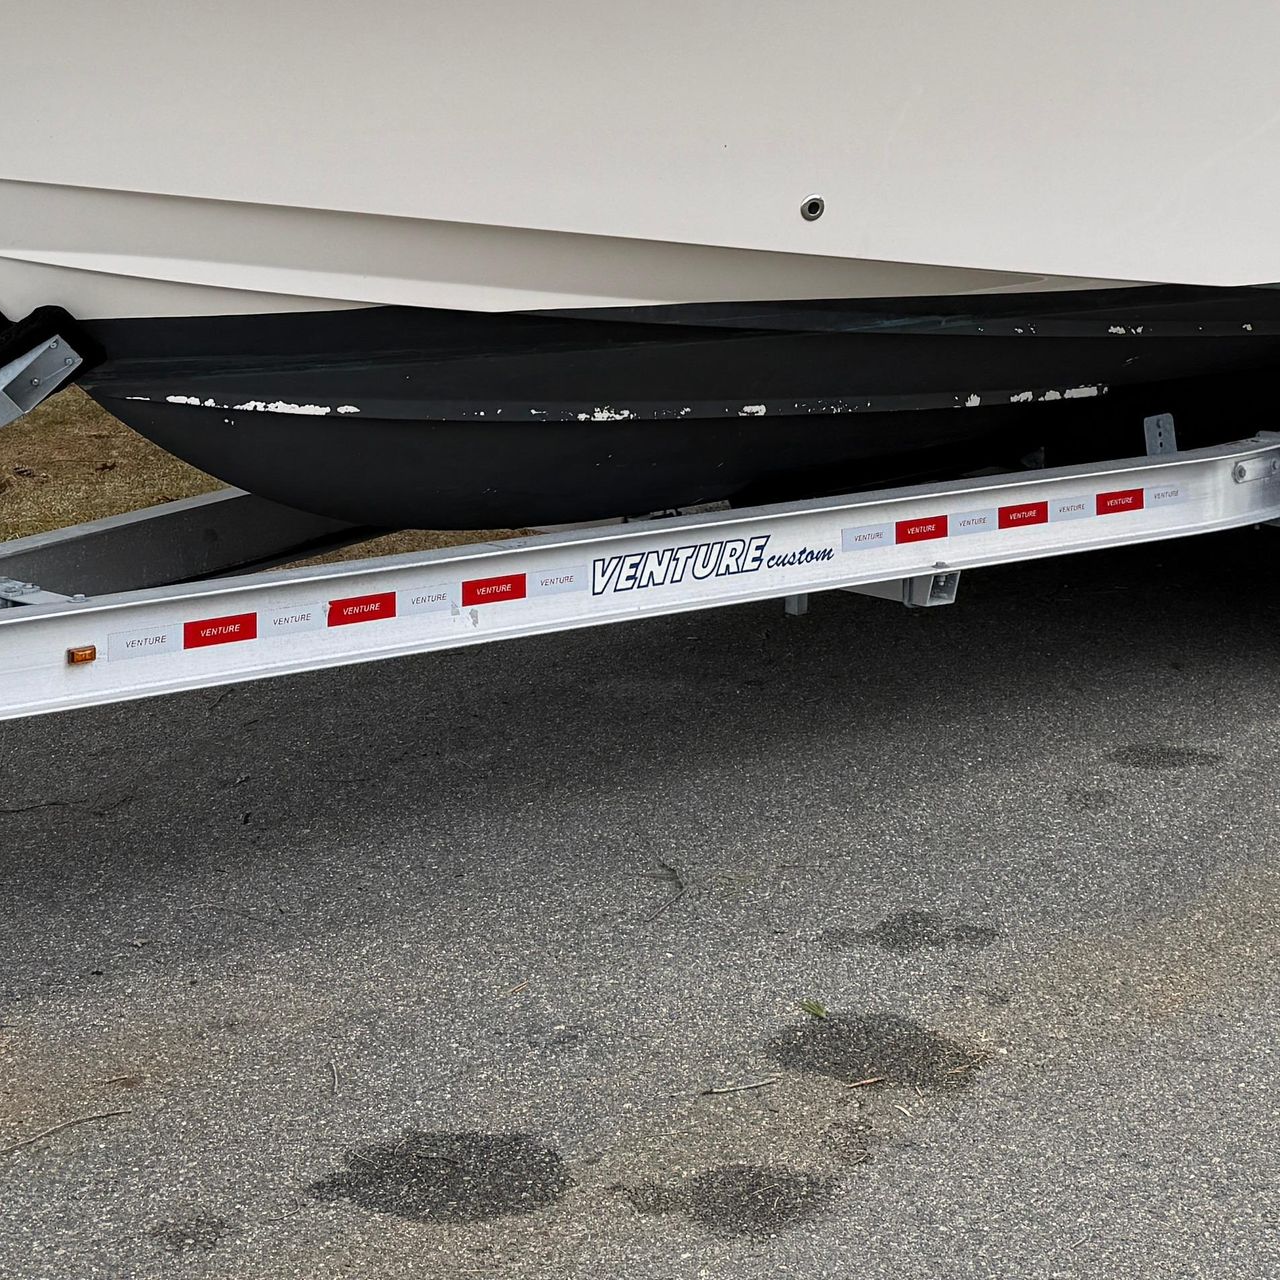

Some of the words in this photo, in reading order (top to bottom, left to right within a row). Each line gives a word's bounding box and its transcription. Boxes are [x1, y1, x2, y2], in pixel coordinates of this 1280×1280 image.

[1153, 489, 1180, 500] VENTURE
[1107, 496, 1134, 507] VENTURE
[1058, 503, 1086, 513] VENTURE
[1009, 509, 1038, 520] VENTURE
[958, 516, 988, 527] VENTURE
[907, 523, 937, 535] VENTURE
[854, 531, 884, 542] VENTURE
[592, 535, 771, 596] VENTURE
[766, 546, 835, 569] custom
[540, 575, 574, 586] VENTURE
[476, 583, 512, 596] VENTURE
[411, 592, 448, 605] VENTURE
[342, 602, 381, 615] VENTURE
[272, 613, 312, 626] VENTURE
[200, 623, 241, 637] VENTURE
[125, 635, 167, 648] VENTURE
